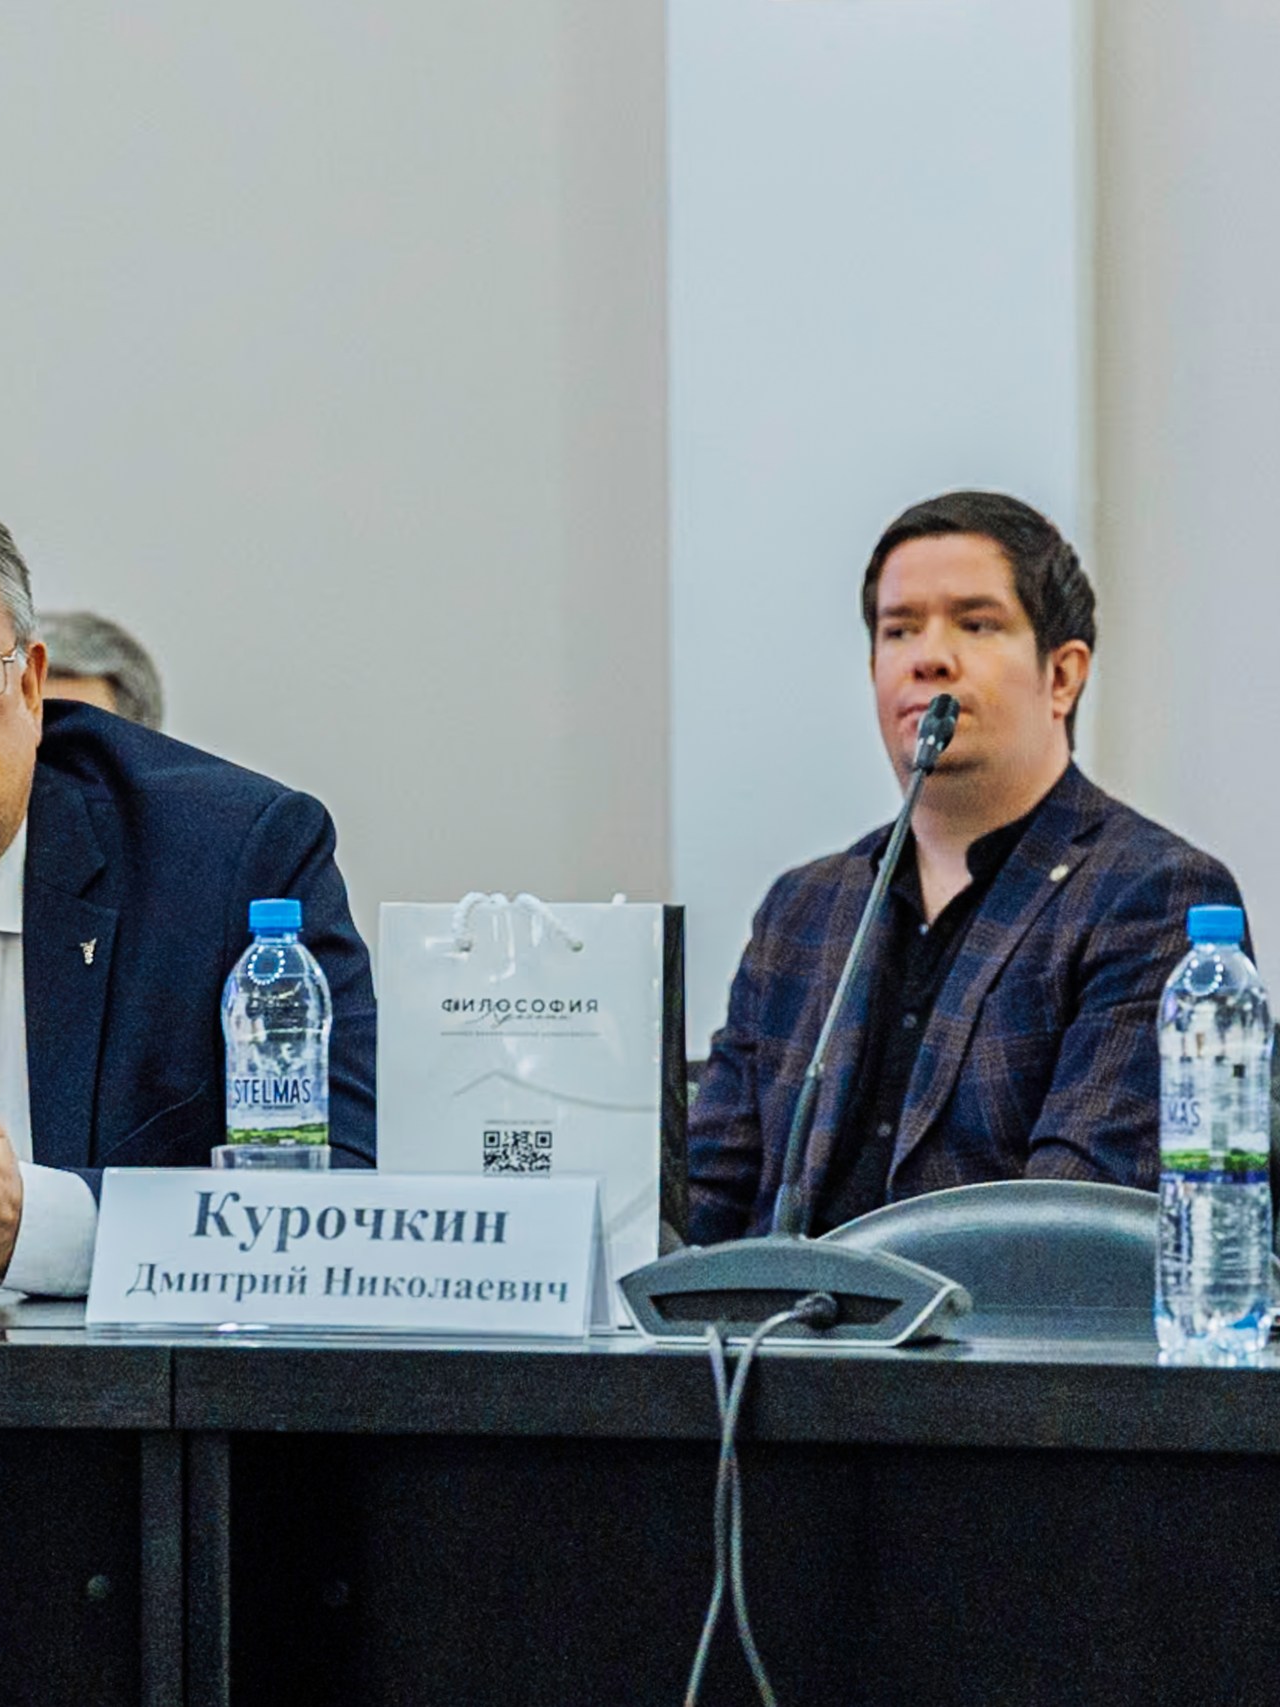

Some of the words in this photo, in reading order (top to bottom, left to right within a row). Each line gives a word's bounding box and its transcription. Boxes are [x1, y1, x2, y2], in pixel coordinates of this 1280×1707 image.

[441, 998, 598, 1013] ФИЛОСОФИЯ
[234, 1079, 311, 1104] STELMAS
[192, 1190, 508, 1252] Курочкин
[125, 1263, 308, 1303] Дмитрий
[323, 1266, 569, 1304] Николаевич
